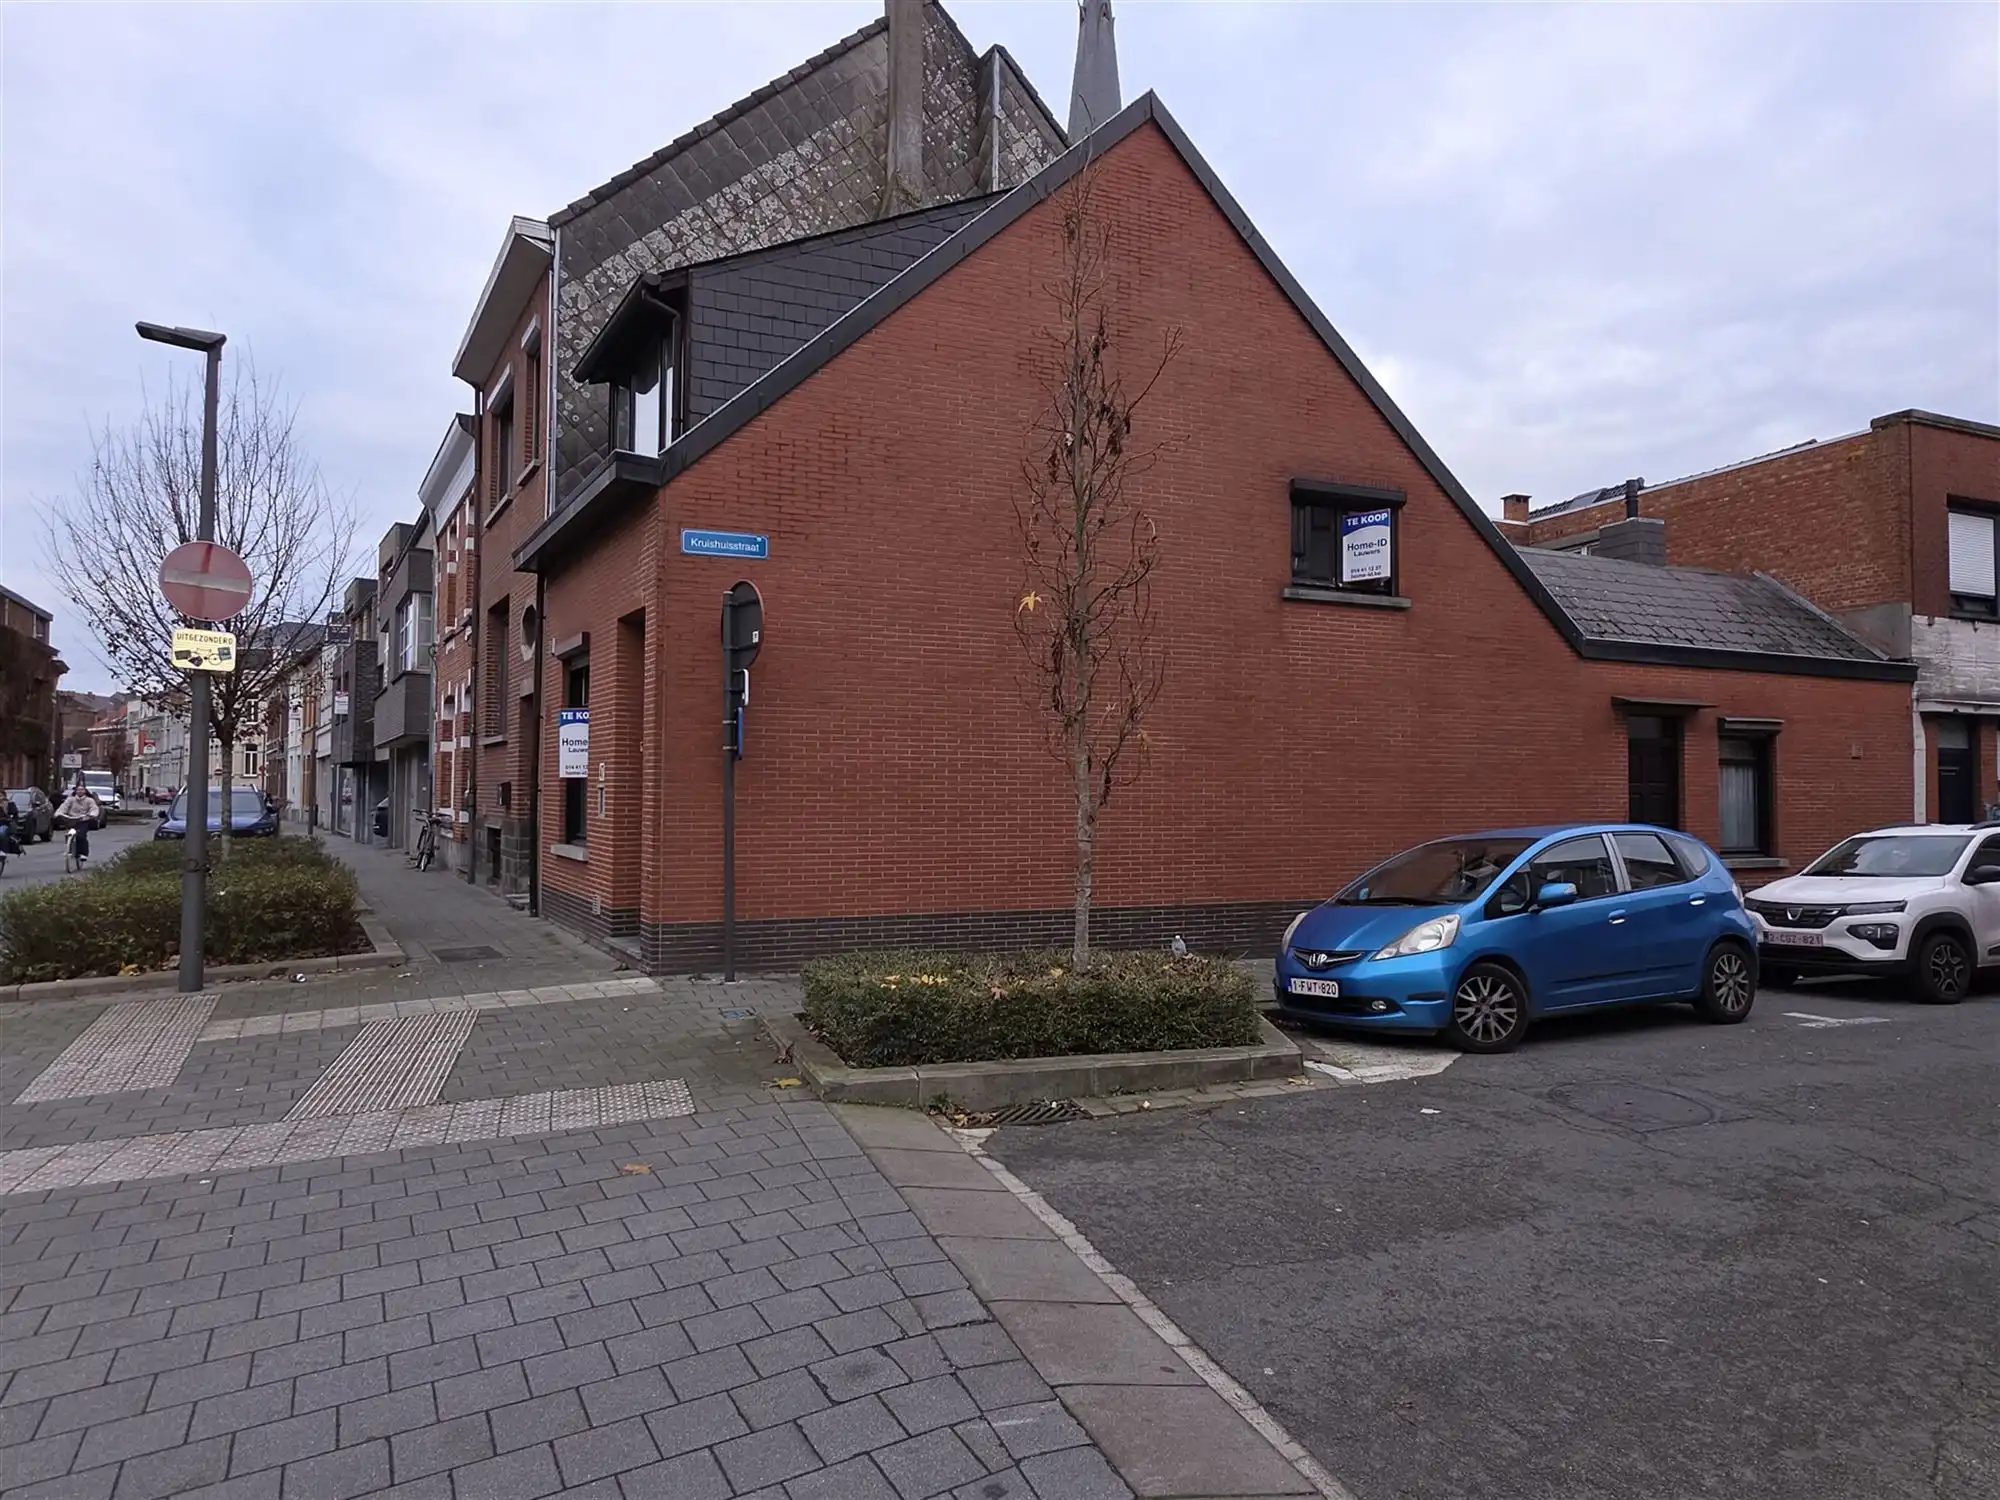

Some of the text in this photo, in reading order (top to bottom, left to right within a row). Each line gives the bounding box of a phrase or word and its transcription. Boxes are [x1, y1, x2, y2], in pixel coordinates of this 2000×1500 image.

[1346, 512, 1388, 526] TE KOOP
[690, 537, 760, 553] Kruishuisstraat
[1347, 538, 1388, 551] Home-ID
[1353, 548, 1381, 557] Lauwers
[176, 632, 234, 645] UITGEZONDERD
[561, 711, 589, 720] TE KO
[561, 738, 588, 747] Home
[1293, 980, 1337, 996] 1-FWT-820
